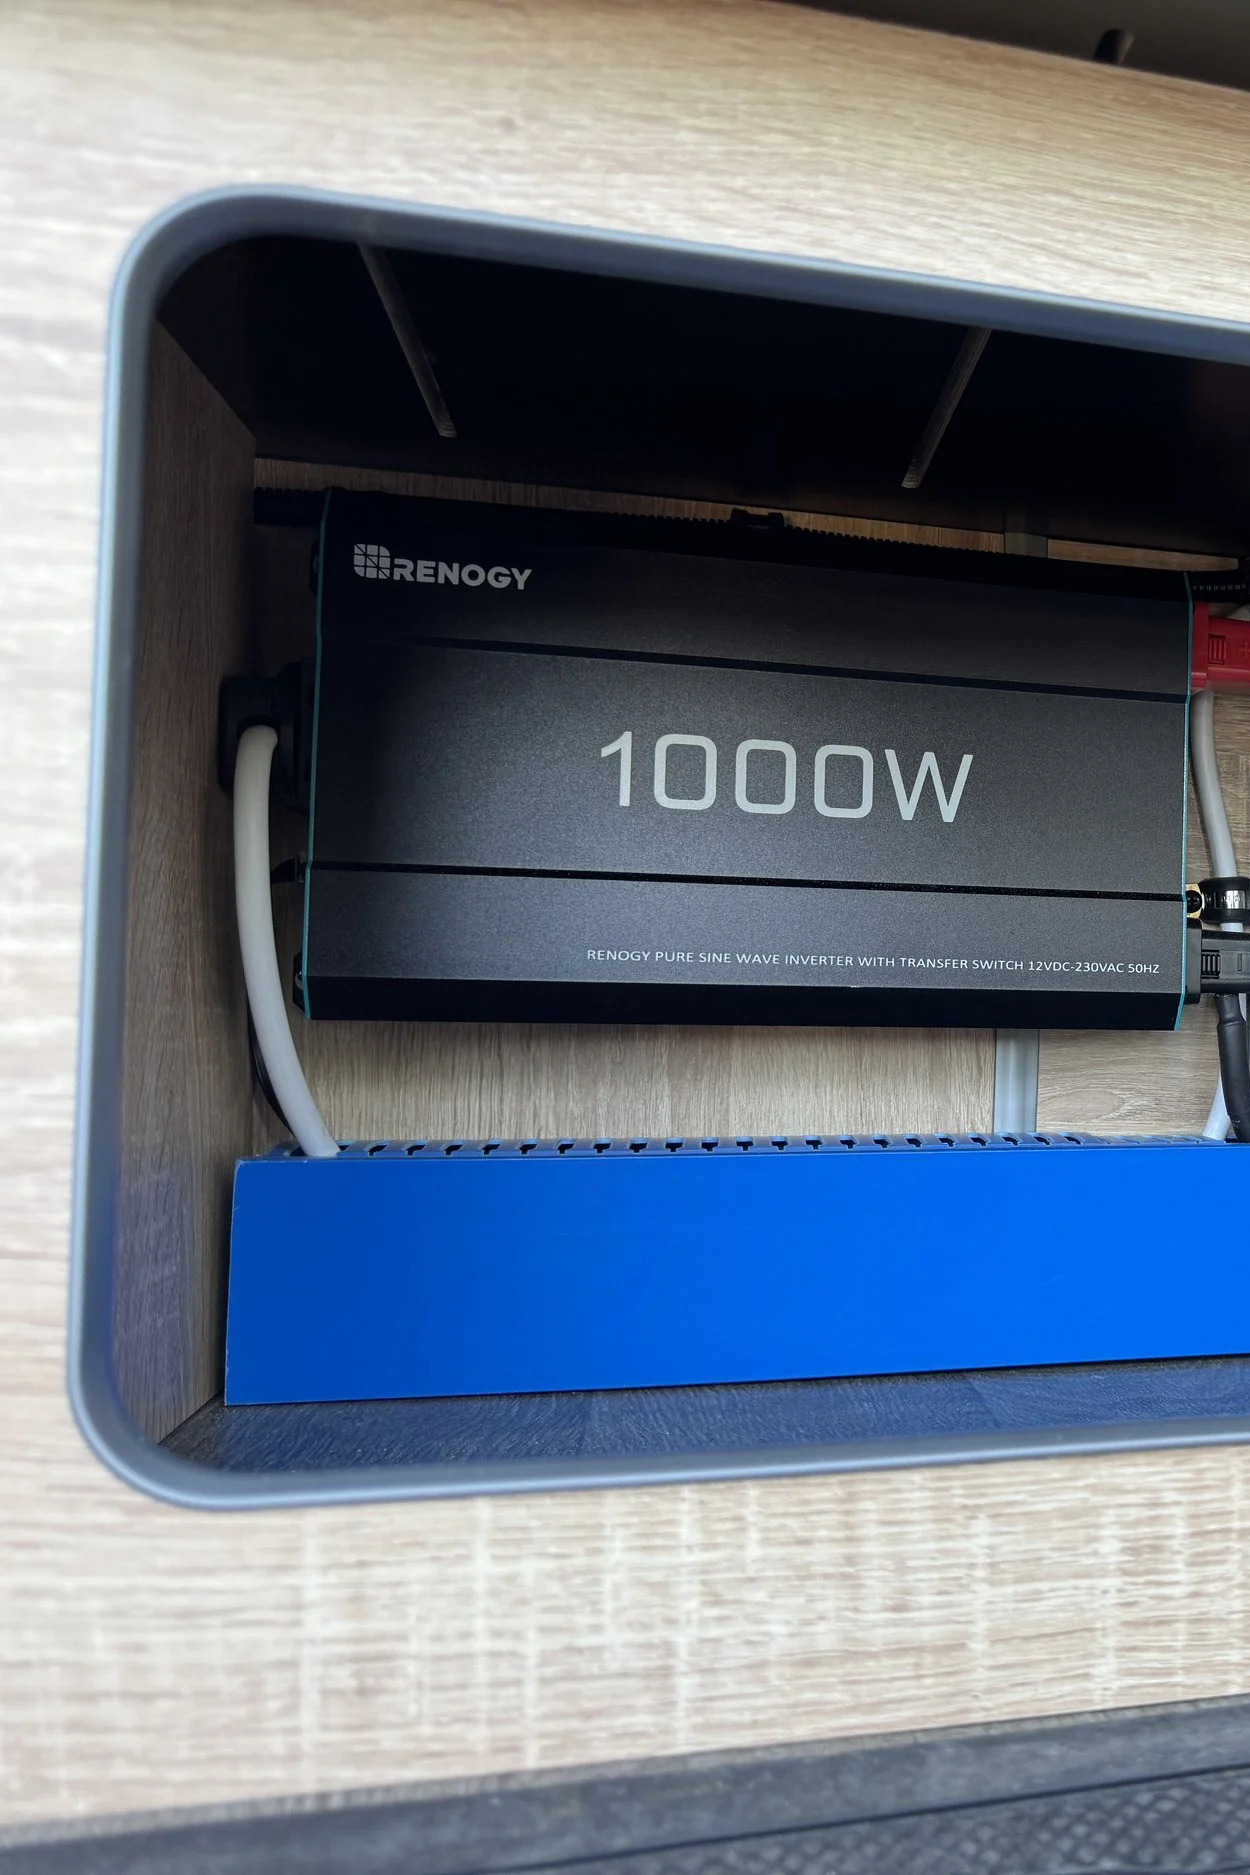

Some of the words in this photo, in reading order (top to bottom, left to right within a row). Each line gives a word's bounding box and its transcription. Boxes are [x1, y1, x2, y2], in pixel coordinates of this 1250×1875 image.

[393, 558, 532, 590] RENOGY
[600, 730, 973, 823] 1000W
[587, 949, 651, 962] RENOGY
[655, 951, 695, 963] PURE
[699, 952, 732, 964] SINE
[736, 953, 781, 965] WAVE
[785, 955, 854, 967] INVERTER
[858, 956, 896, 968] WITH
[899, 957, 969, 970] TRANSFER
[972, 959, 1024, 971] SWITCH
[1028, 960, 1125, 973] 12VDC-230VAC
[1128, 963, 1160, 974] 50HZ
